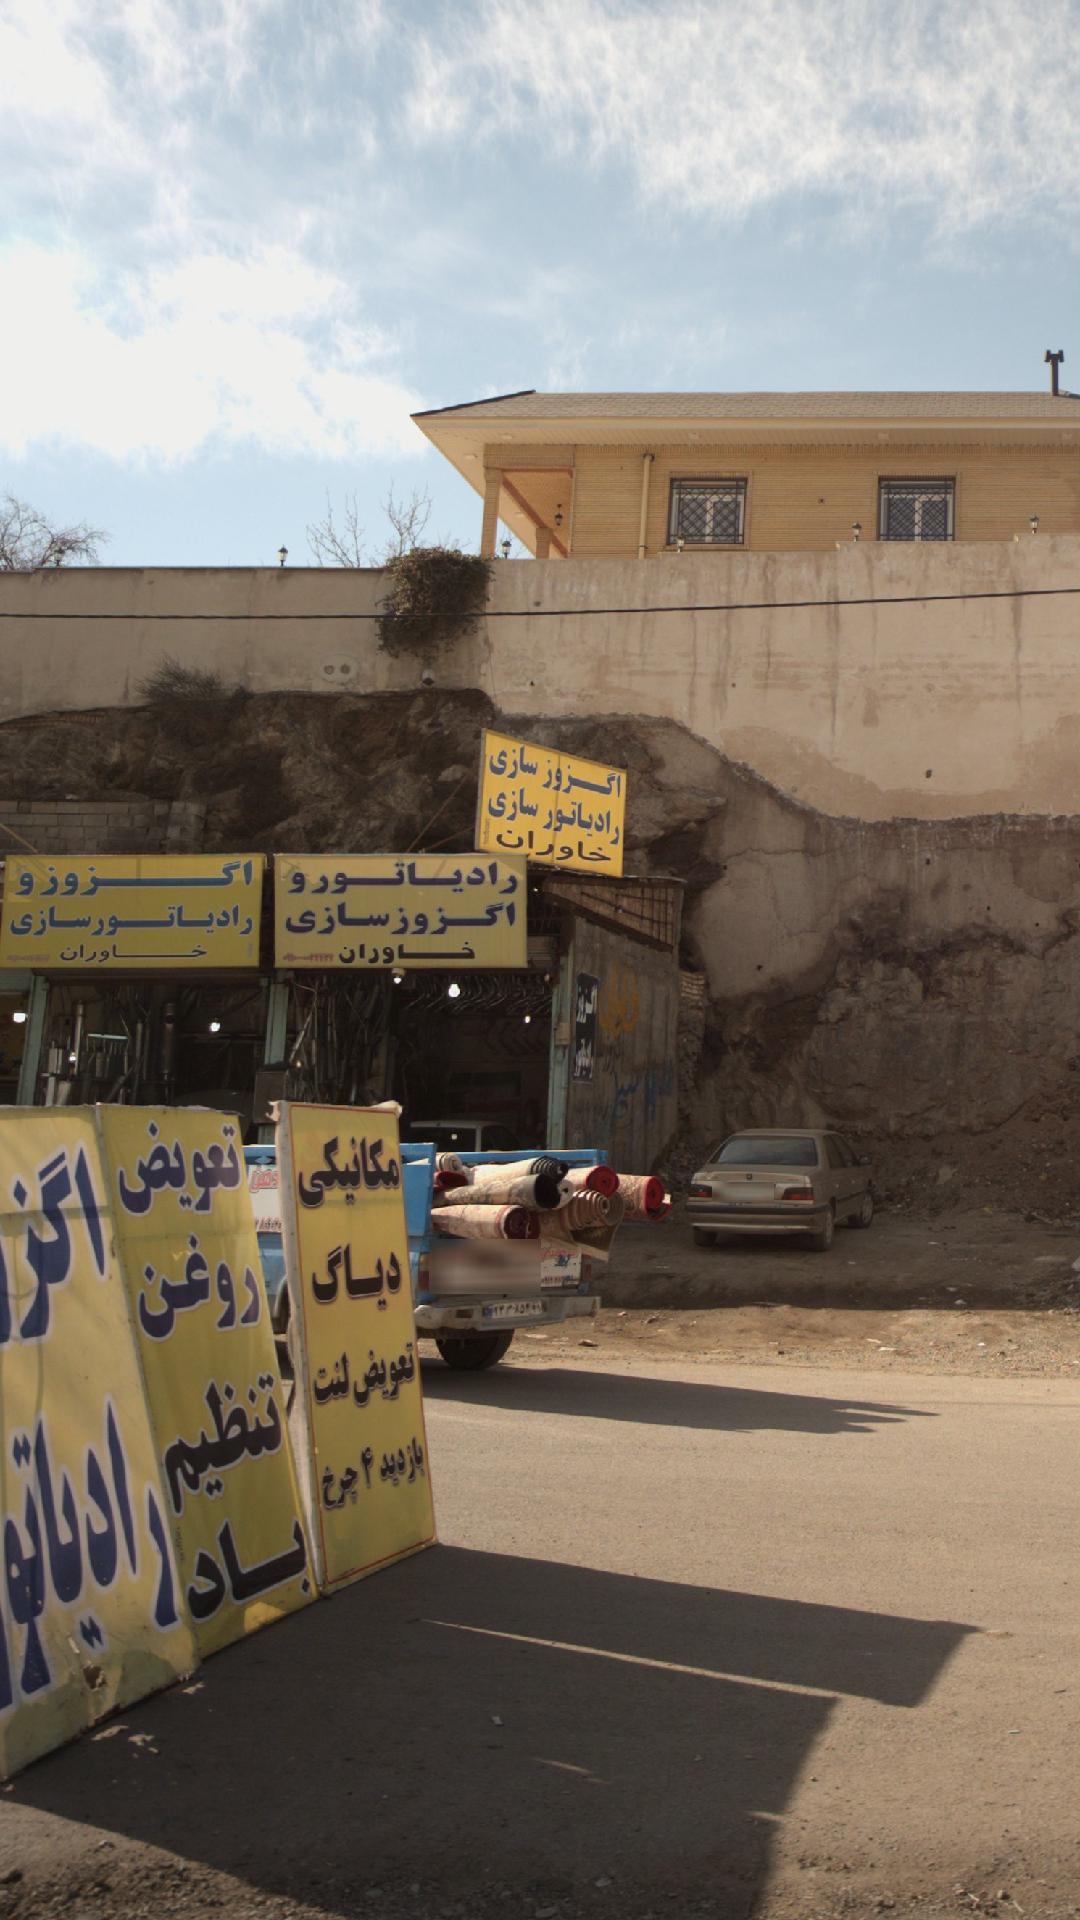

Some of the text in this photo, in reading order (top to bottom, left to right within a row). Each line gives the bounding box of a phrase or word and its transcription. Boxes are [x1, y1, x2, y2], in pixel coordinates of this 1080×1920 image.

[489, 746, 621, 798] اگزوز سازی
[488, 788, 620, 844] رادیاتور سازی
[39, 859, 254, 896] اگزوز
[311, 861, 518, 894] رادیاتور
[59, 944, 207, 962] خاوران
[338, 941, 476, 964] خاوران
[118, 1121, 241, 1214] تعویض
[298, 1136, 400, 1208] مکانیکی
[0, 1146, 105, 1344] اگز
[311, 1243, 402, 1311] دیاگ
[138, 1234, 261, 1339] روغن
[313, 1342, 416, 1407] تعویض لنت
[164, 1373, 283, 1515] تنظیم
[322, 1437, 424, 1509] بازدید ۴ چرخ
[187, 1519, 310, 1620] باد
